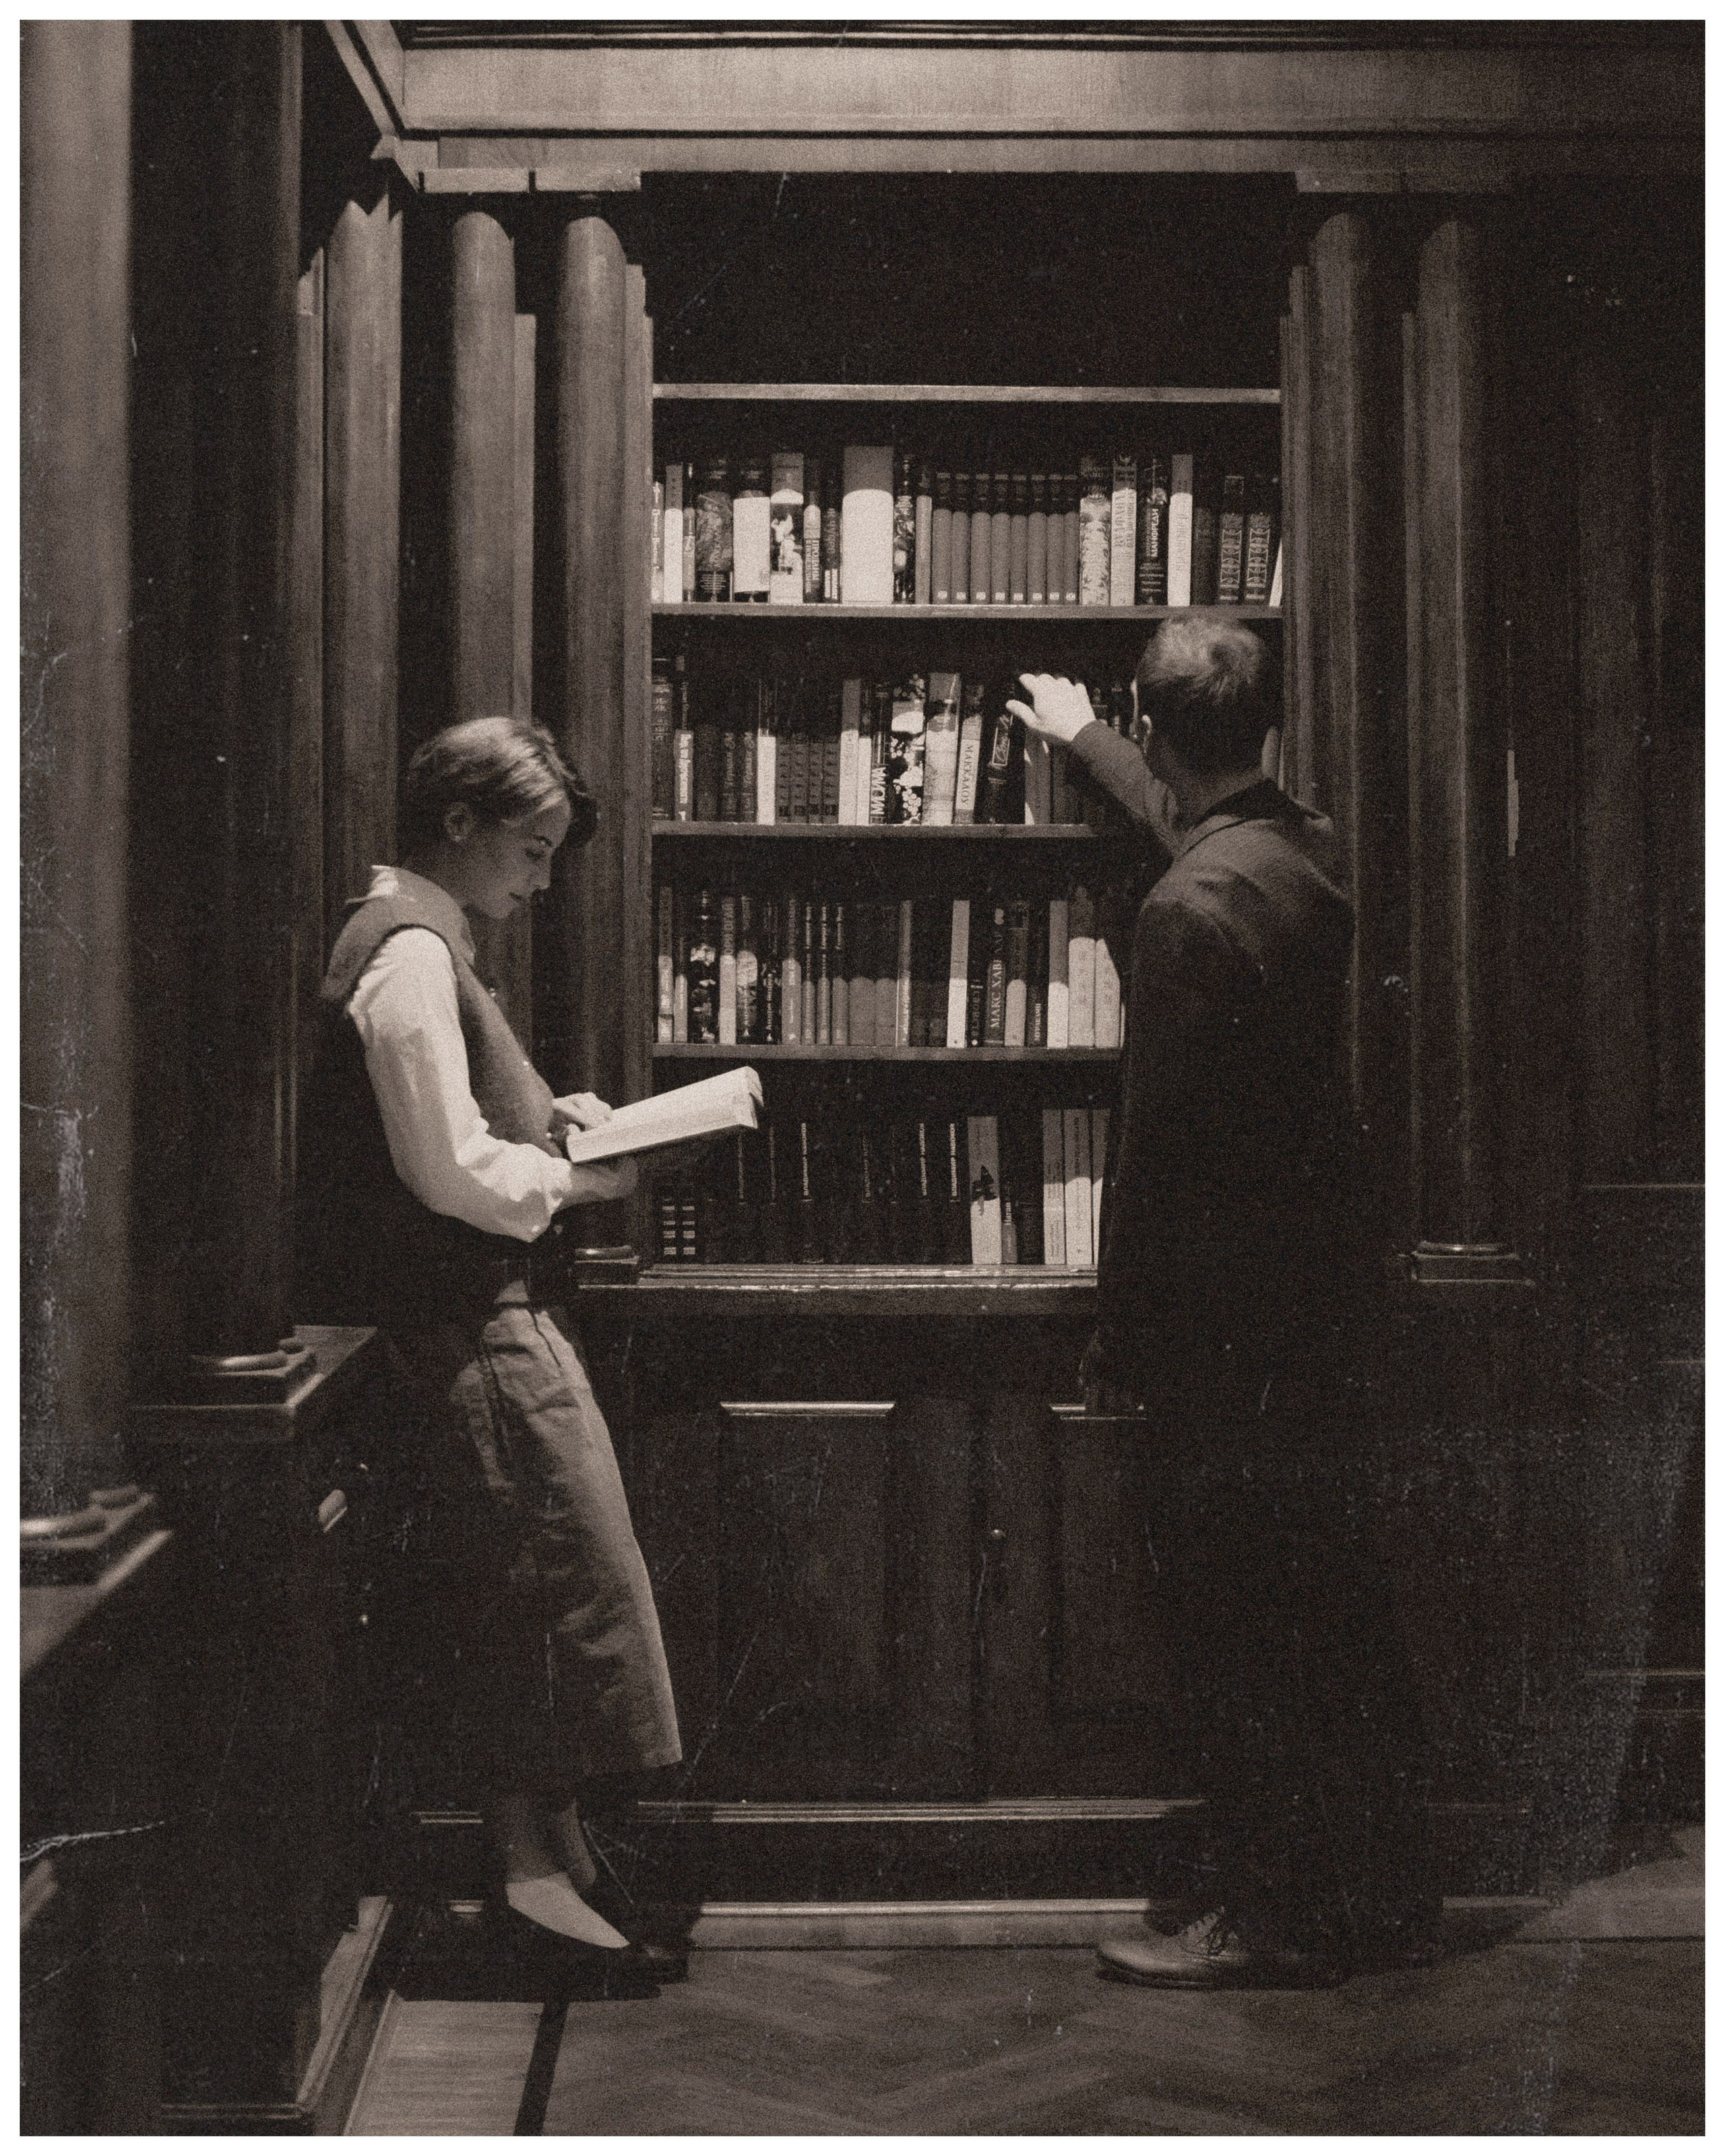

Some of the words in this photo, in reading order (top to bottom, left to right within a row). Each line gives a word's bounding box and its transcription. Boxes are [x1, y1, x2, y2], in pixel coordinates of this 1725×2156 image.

[1151, 509, 1159, 557] МАНФРЕДИ
[961, 744, 974, 804] МАККАЛОУ
[991, 992, 1001, 1028] МАКС
